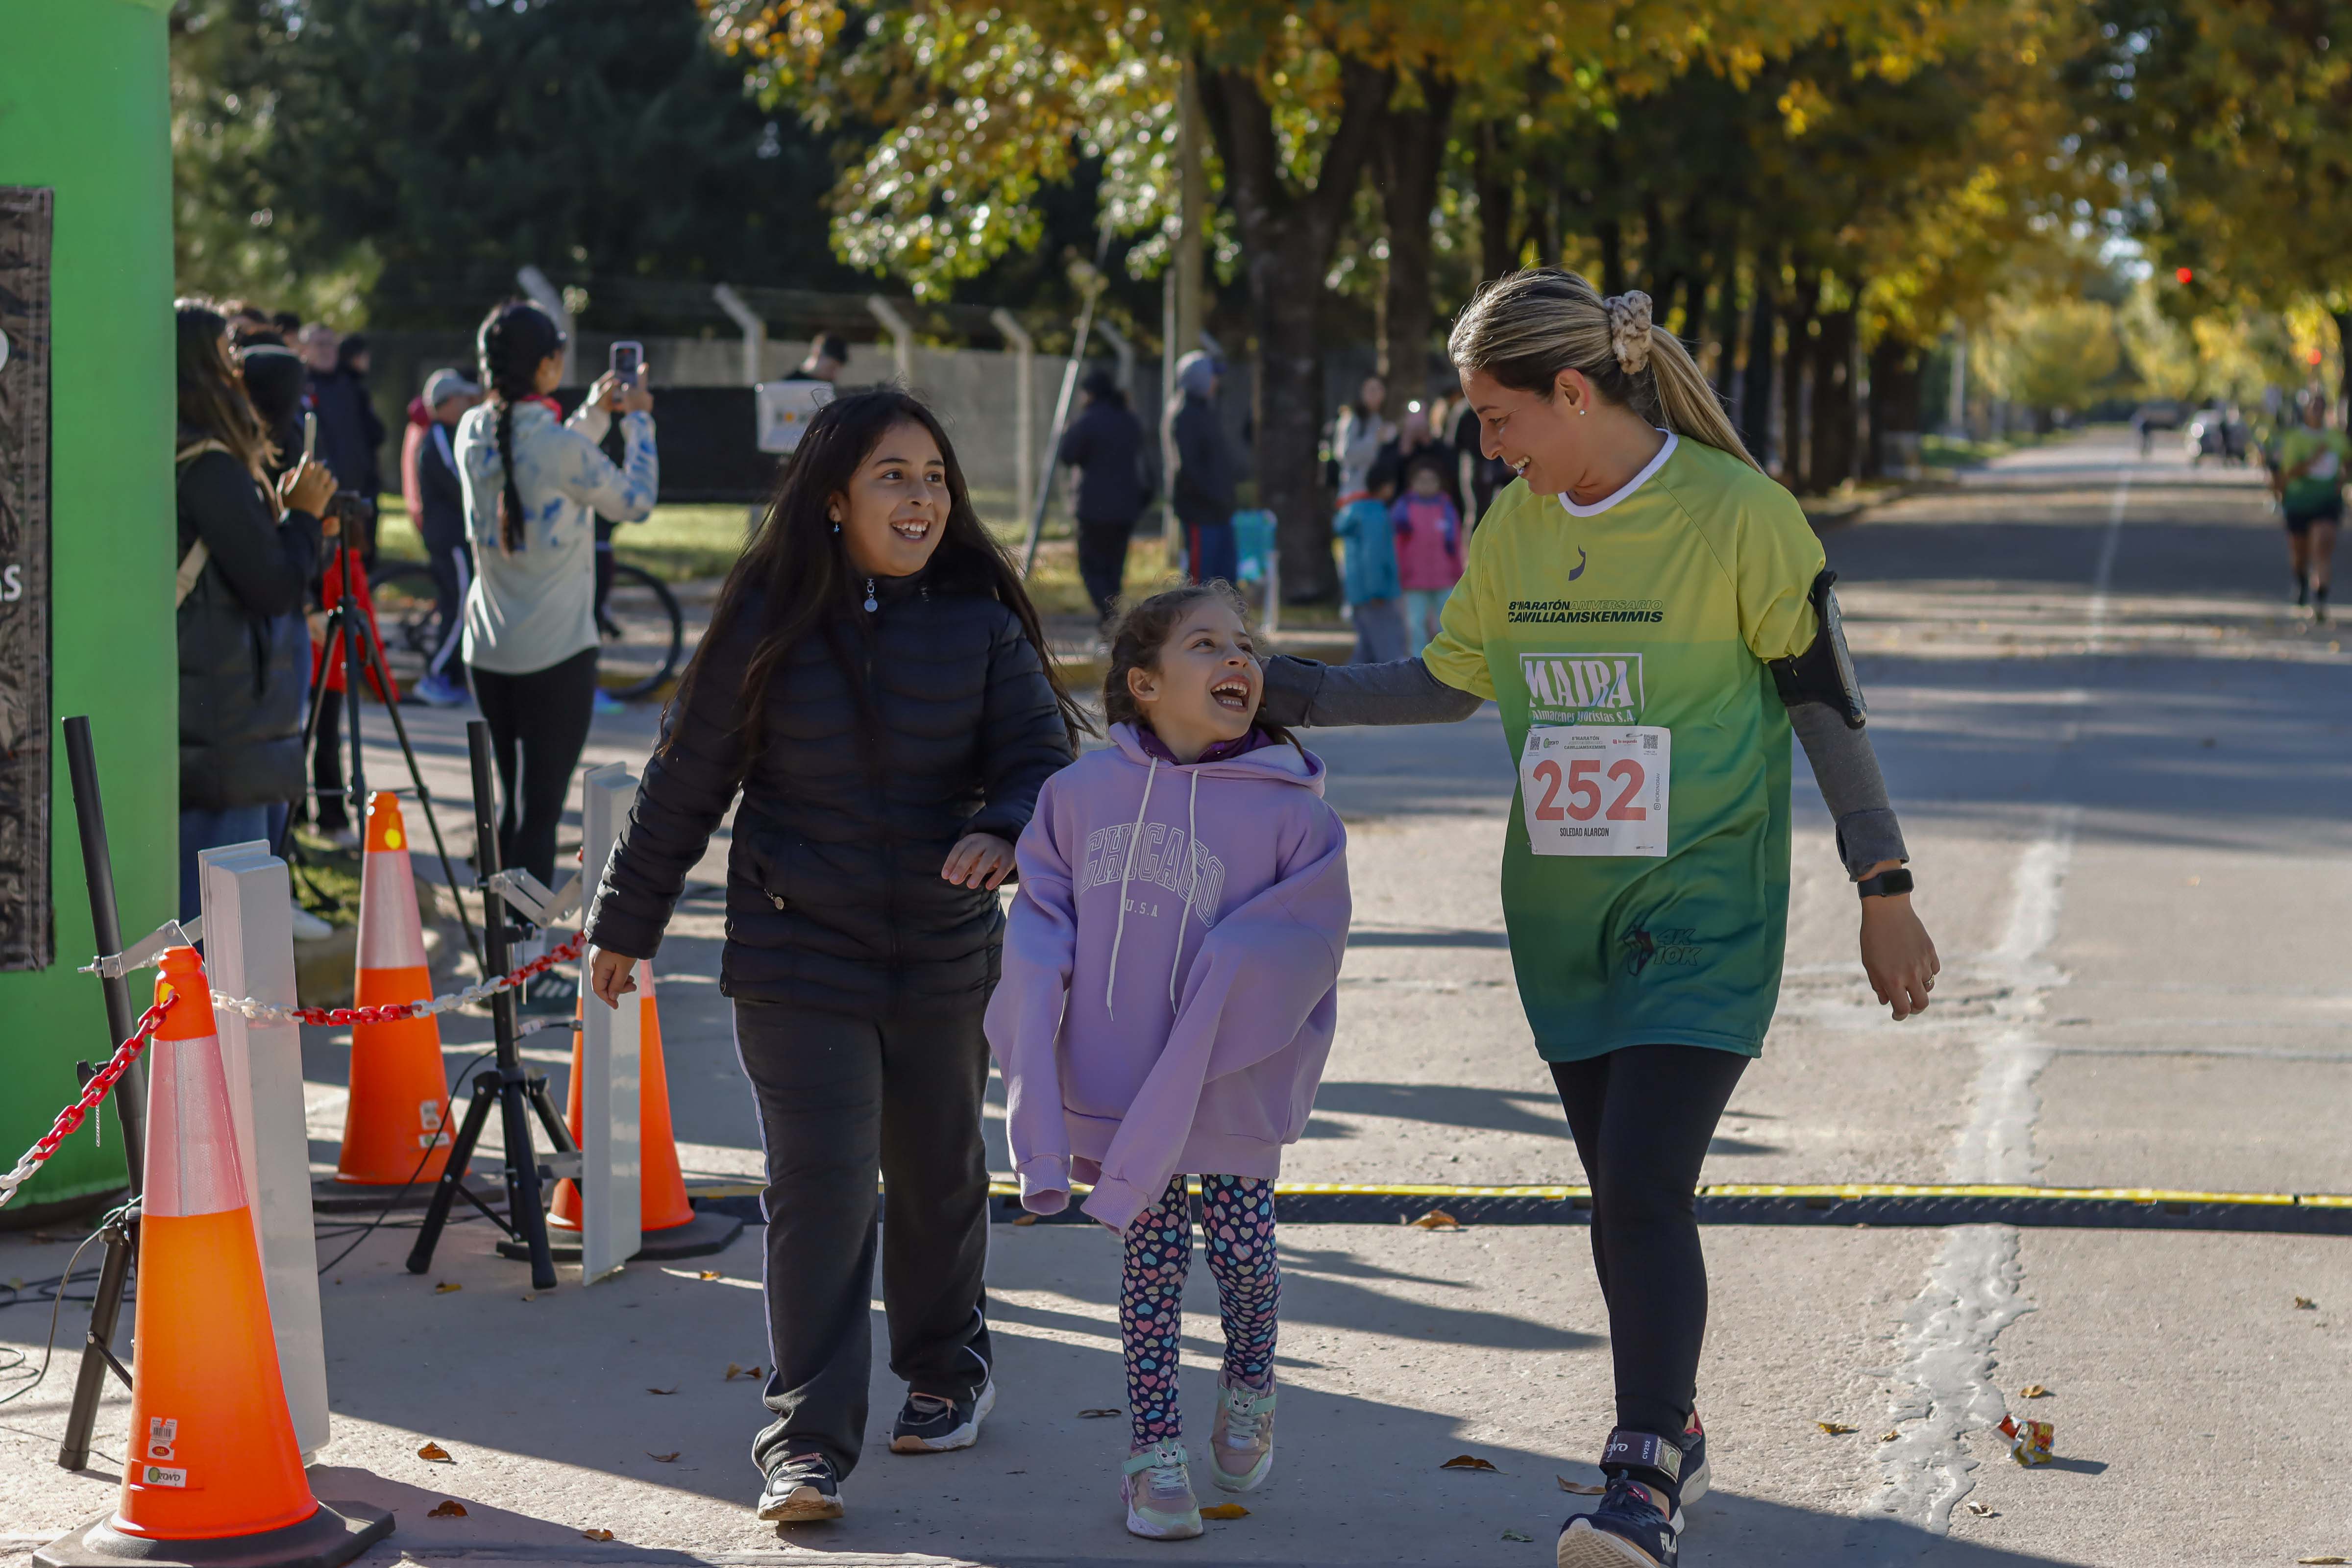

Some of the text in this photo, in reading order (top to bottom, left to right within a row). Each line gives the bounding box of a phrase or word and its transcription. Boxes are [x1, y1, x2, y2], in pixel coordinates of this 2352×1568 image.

[0, 564, 23, 602] S
[1569, 600, 1663, 610] ANIVERSARIO
[1524, 660, 1635, 709] MAIRA
[1532, 710, 1574, 722] Almacenes
[1533, 760, 1646, 821] 252
[1560, 827, 1609, 837] SOLEDAD ALARCON
[1079, 822, 1225, 928] CHICAGO
[1642, 1440, 1651, 1459] CV252
[1660, 1531, 1677, 1554] FILA
